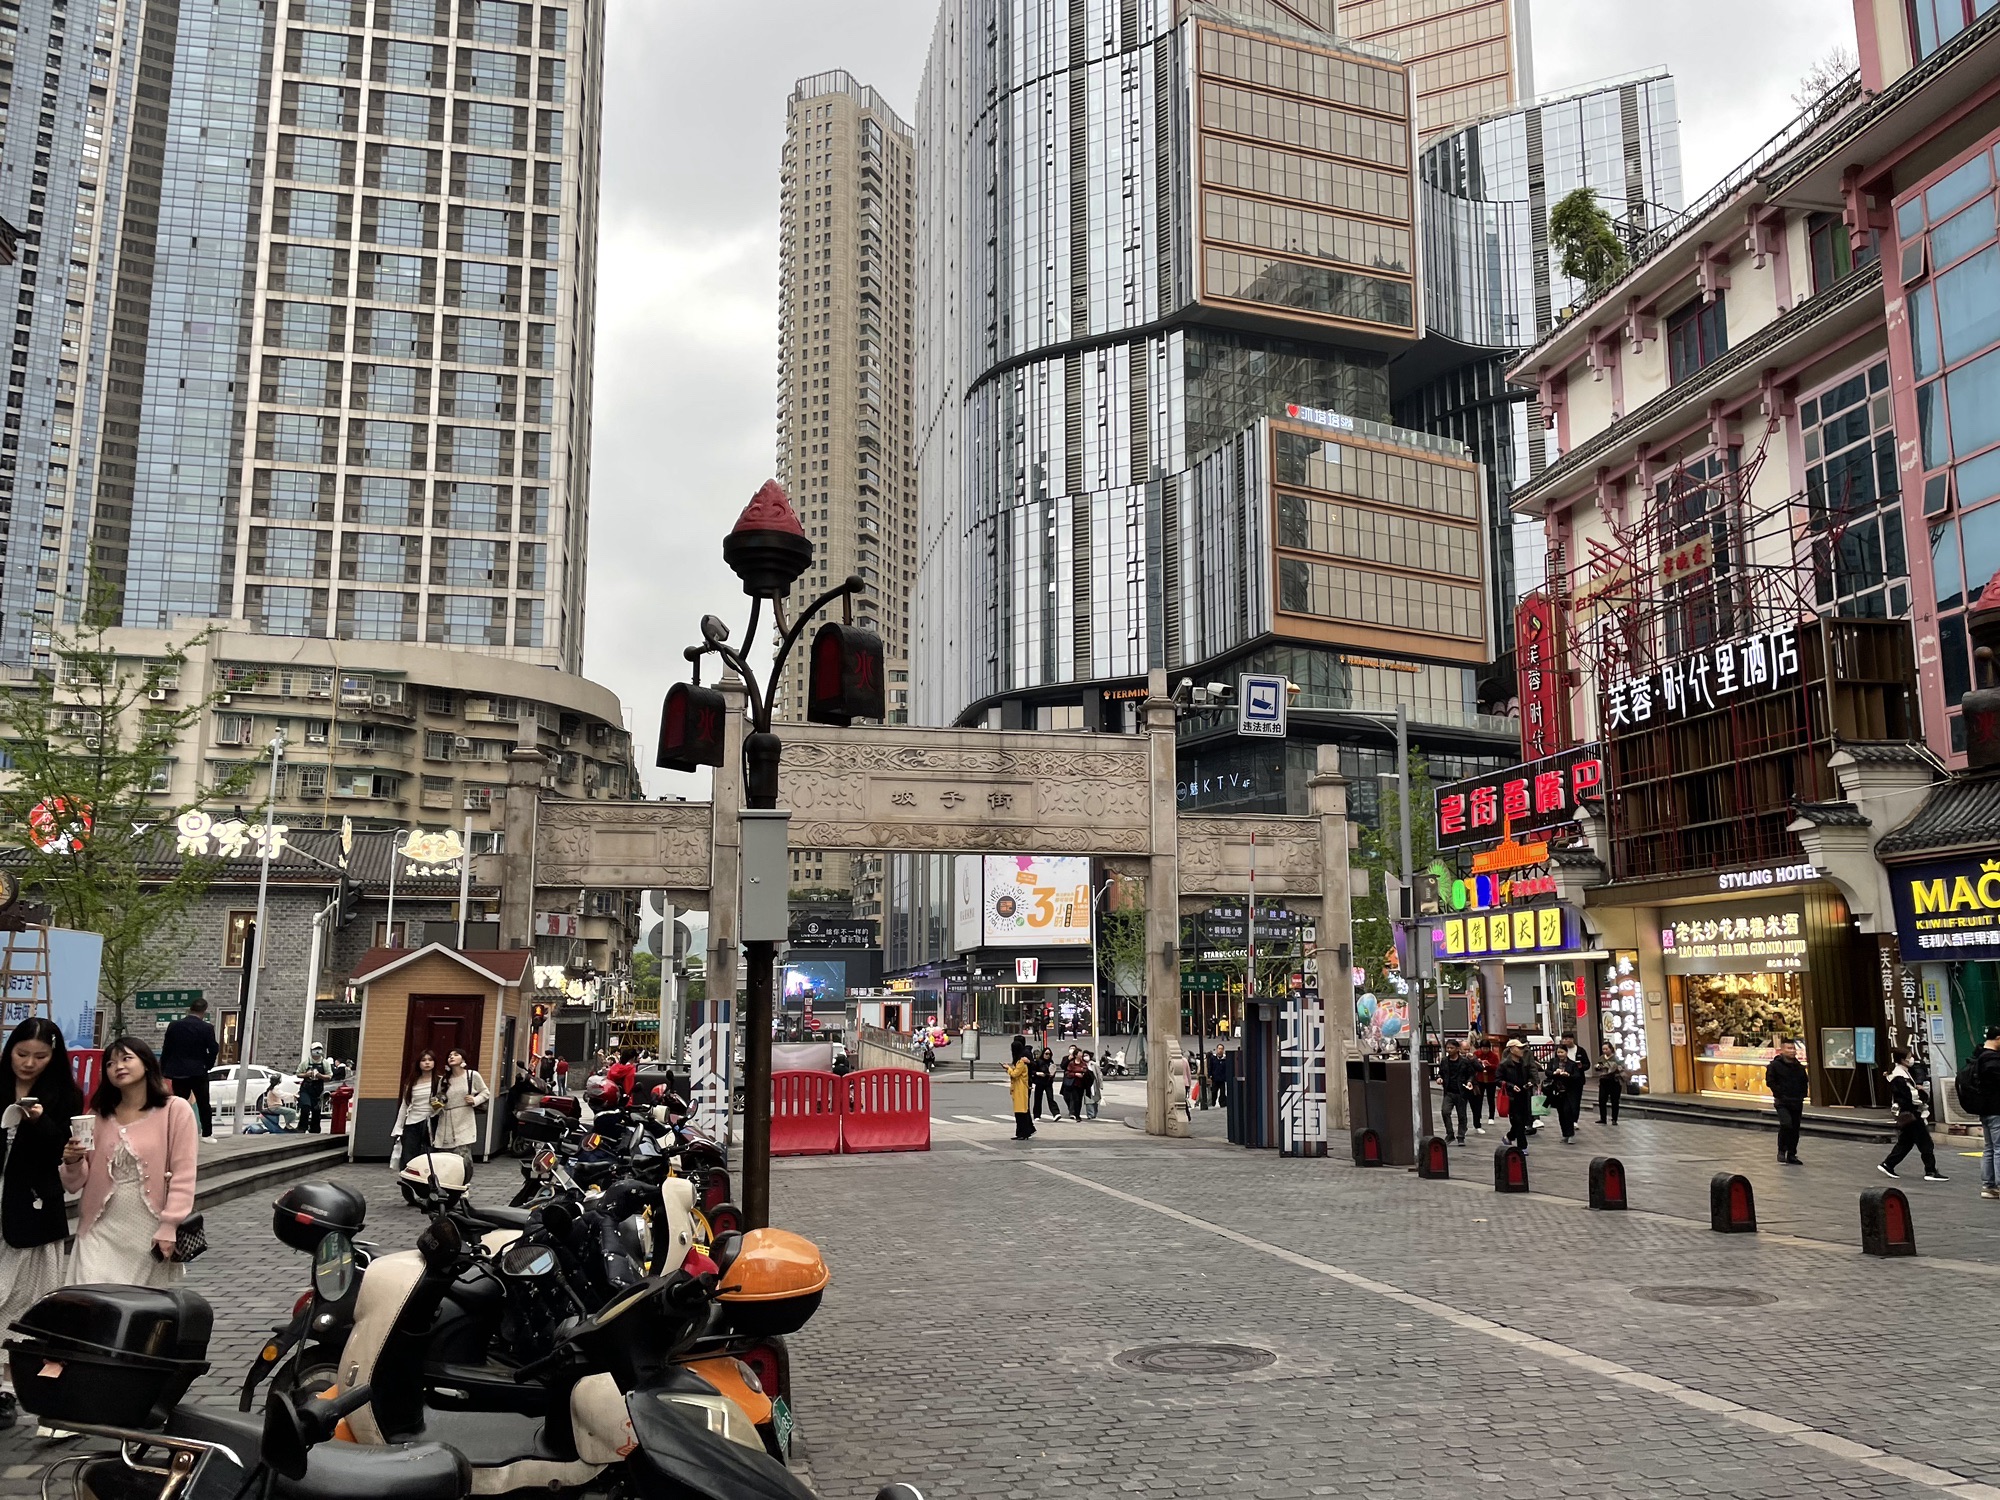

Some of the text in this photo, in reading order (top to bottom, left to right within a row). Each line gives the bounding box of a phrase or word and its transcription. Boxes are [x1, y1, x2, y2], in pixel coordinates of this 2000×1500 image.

[1608, 625, 1799, 730] 芙蓉·时代里酒店
[1242, 721, 1282, 733] 违法抓拍
[891, 790, 1013, 810] 坡子街
[1441, 759, 1602, 835] 老街鱼嘴巴
[1719, 863, 1821, 889] STYLING HOTEL
[1027, 887, 1056, 928] 3
[536, 914, 578, 936] 酒店
[1676, 913, 1800, 942] 老长沙花果糯米酒
[1916, 915, 1994, 930] KIWIFRUIT
[1679, 946, 1692, 958] LAO
[1693, 945, 1717, 958] CHANG
[1718, 943, 1733, 957] SHA
[1733, 942, 1749, 956] HUA
[1749, 941, 1765, 955] GUO
[1765, 940, 1783, 955] NUO
[1918, 930, 2000, 948] 毛利人奇异果酒
[1280, 1001, 1327, 1151] 坡子街
